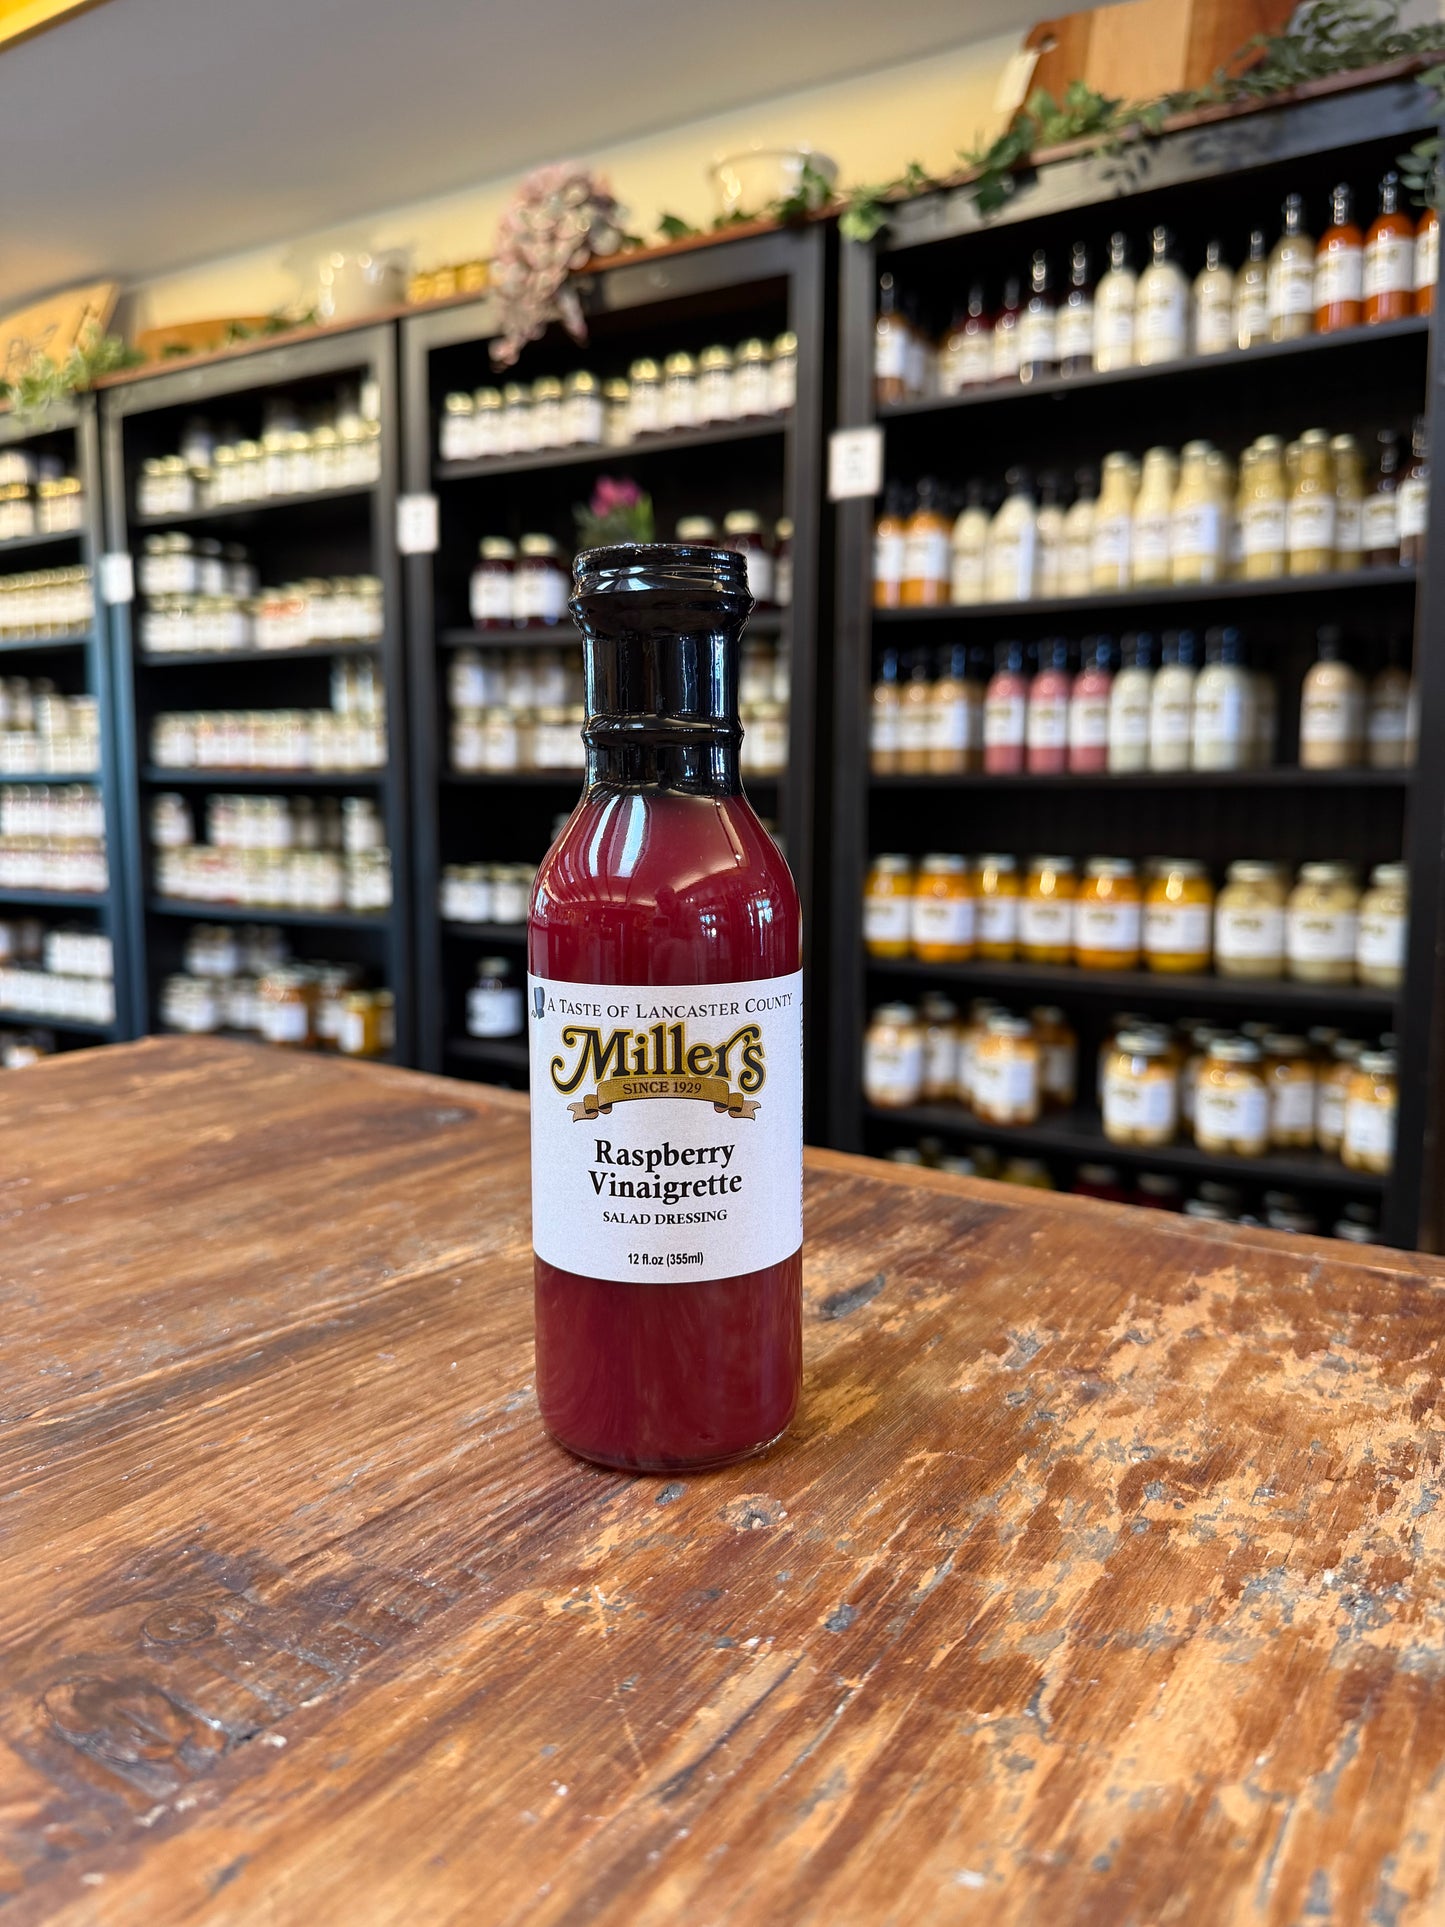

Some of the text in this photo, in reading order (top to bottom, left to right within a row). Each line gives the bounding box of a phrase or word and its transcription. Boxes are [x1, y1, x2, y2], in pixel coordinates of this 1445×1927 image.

[547, 992, 793, 1019] A TASTE OF LANCASTER COUNTY
[551, 1021, 767, 1095] Miller's
[623, 1081, 702, 1095] SINCE 1929
[594, 1139, 735, 1173] Raspberry
[588, 1170, 742, 1205] Vinaigrette
[603, 1209, 728, 1225] SALAD DRESSING
[628, 1252, 639, 1265] 12
[666, 1252, 704, 1267] (355ml)
